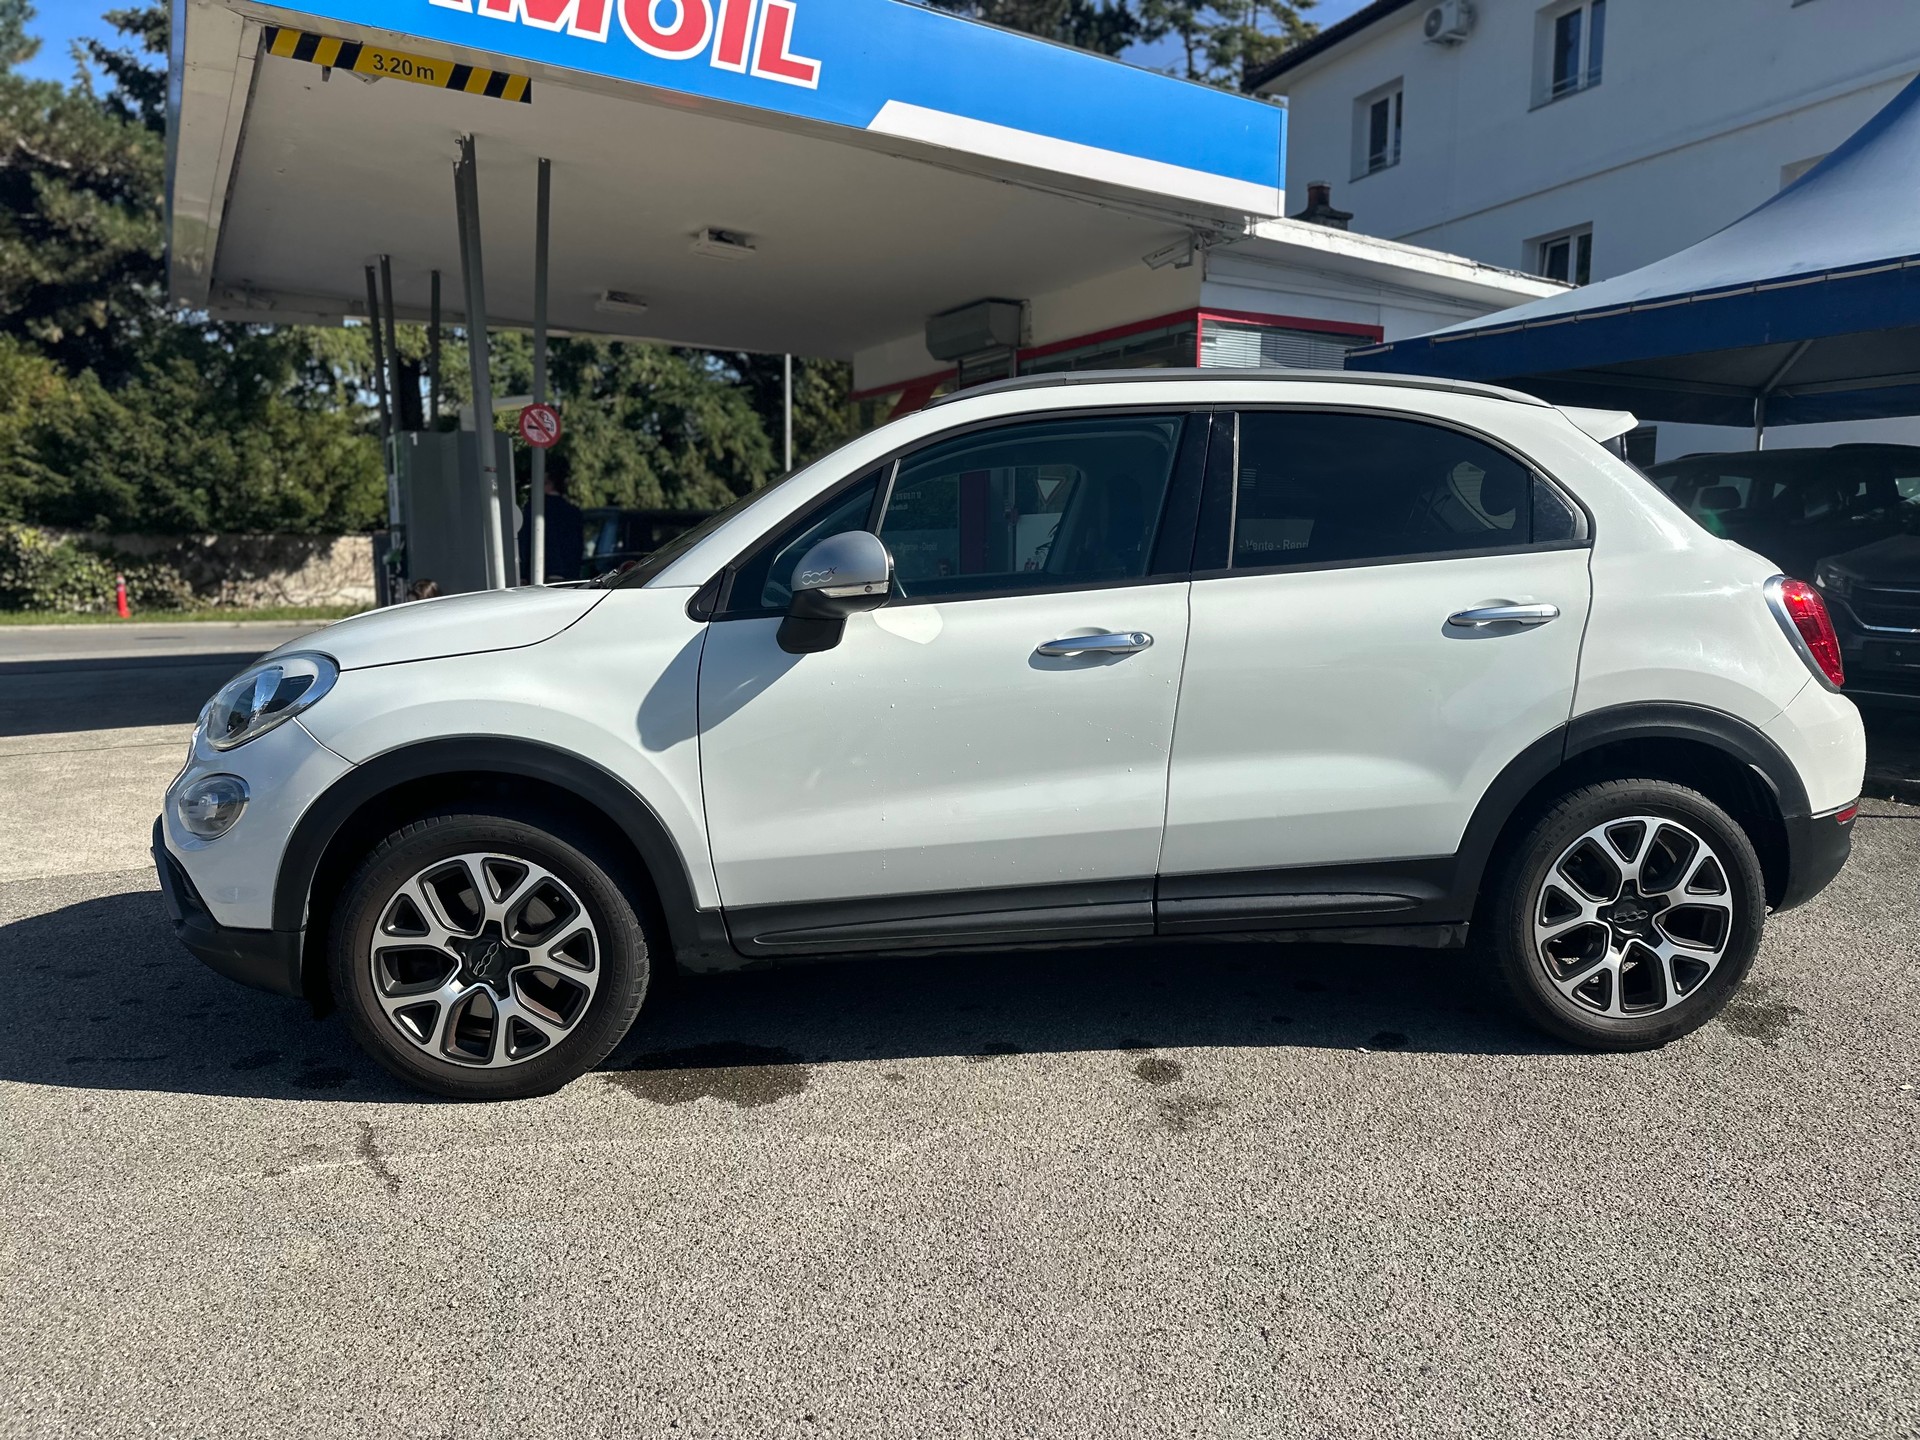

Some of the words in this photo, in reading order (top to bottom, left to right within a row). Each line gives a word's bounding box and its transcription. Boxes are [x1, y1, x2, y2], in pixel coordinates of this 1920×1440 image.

[372, 53, 412, 76] 3.20
[416, 65, 434, 81] m
[409, 430, 418, 446] 1
[1245, 538, 1274, 551] Vente
